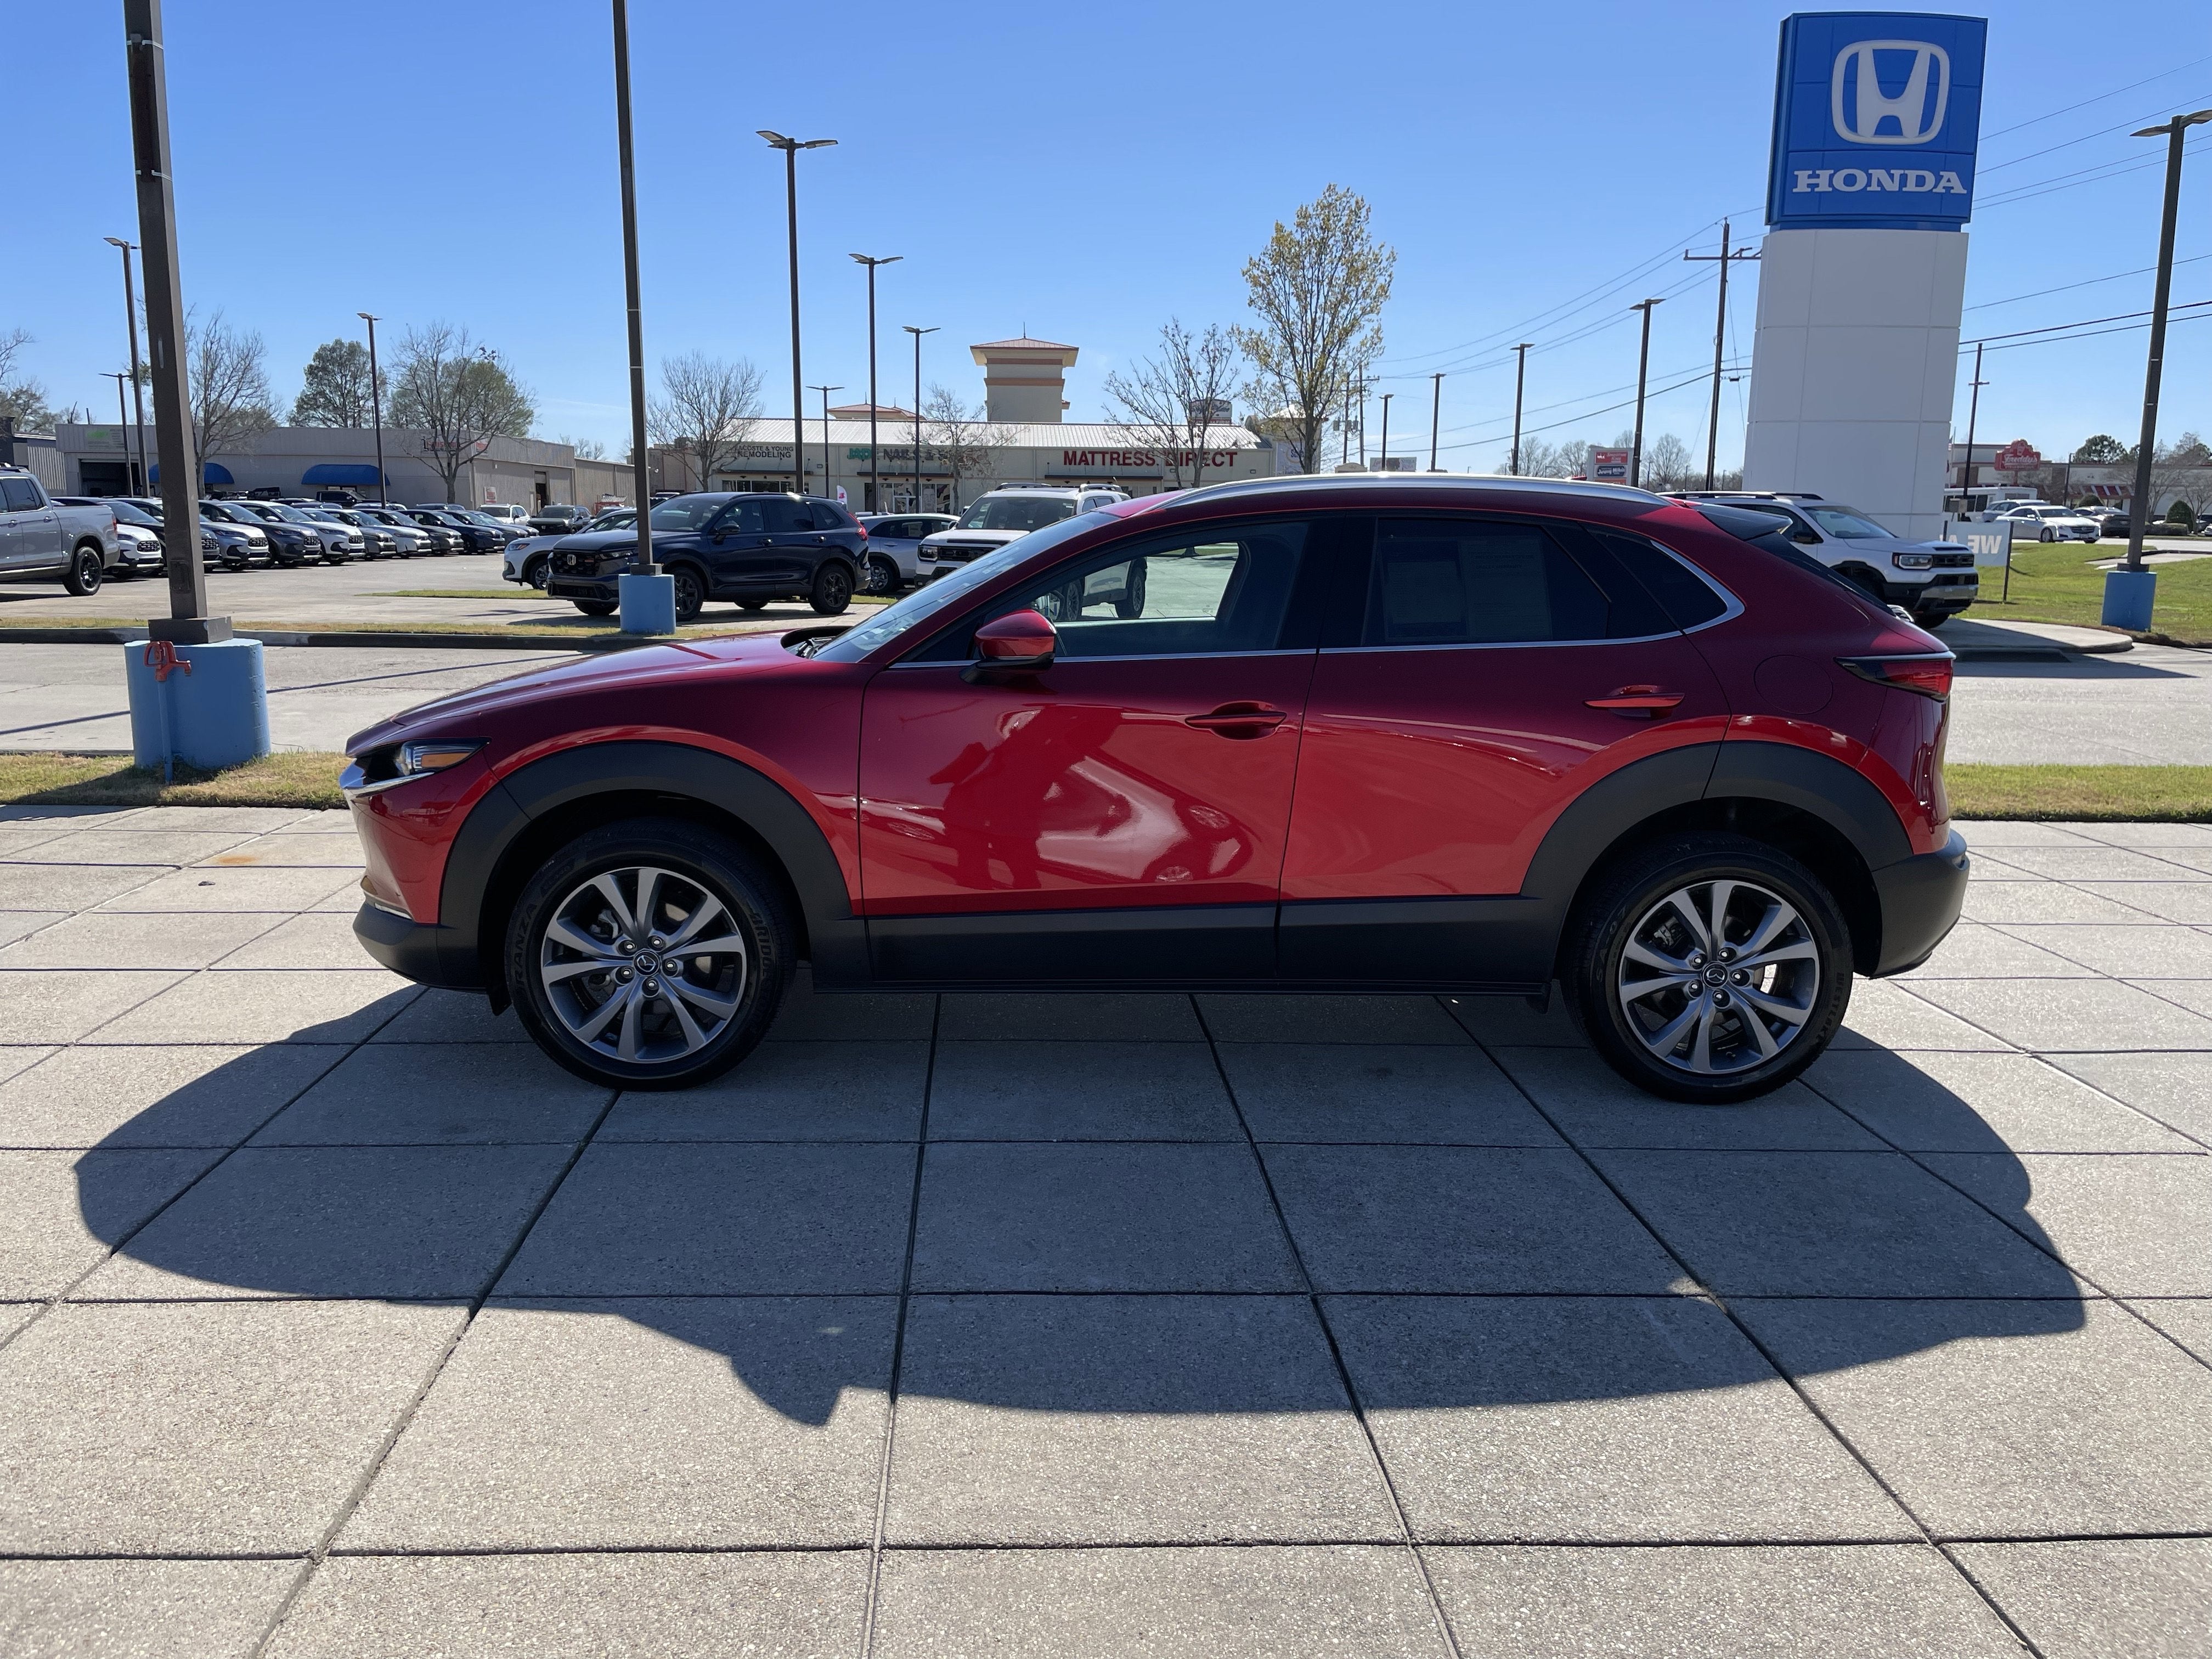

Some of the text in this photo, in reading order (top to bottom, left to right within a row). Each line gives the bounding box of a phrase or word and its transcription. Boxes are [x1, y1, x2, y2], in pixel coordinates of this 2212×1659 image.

[1792, 168, 1967, 194] HONDA
[1064, 450, 1155, 466] MATTRESS
[2004, 454, 2038, 465] Freddy's
